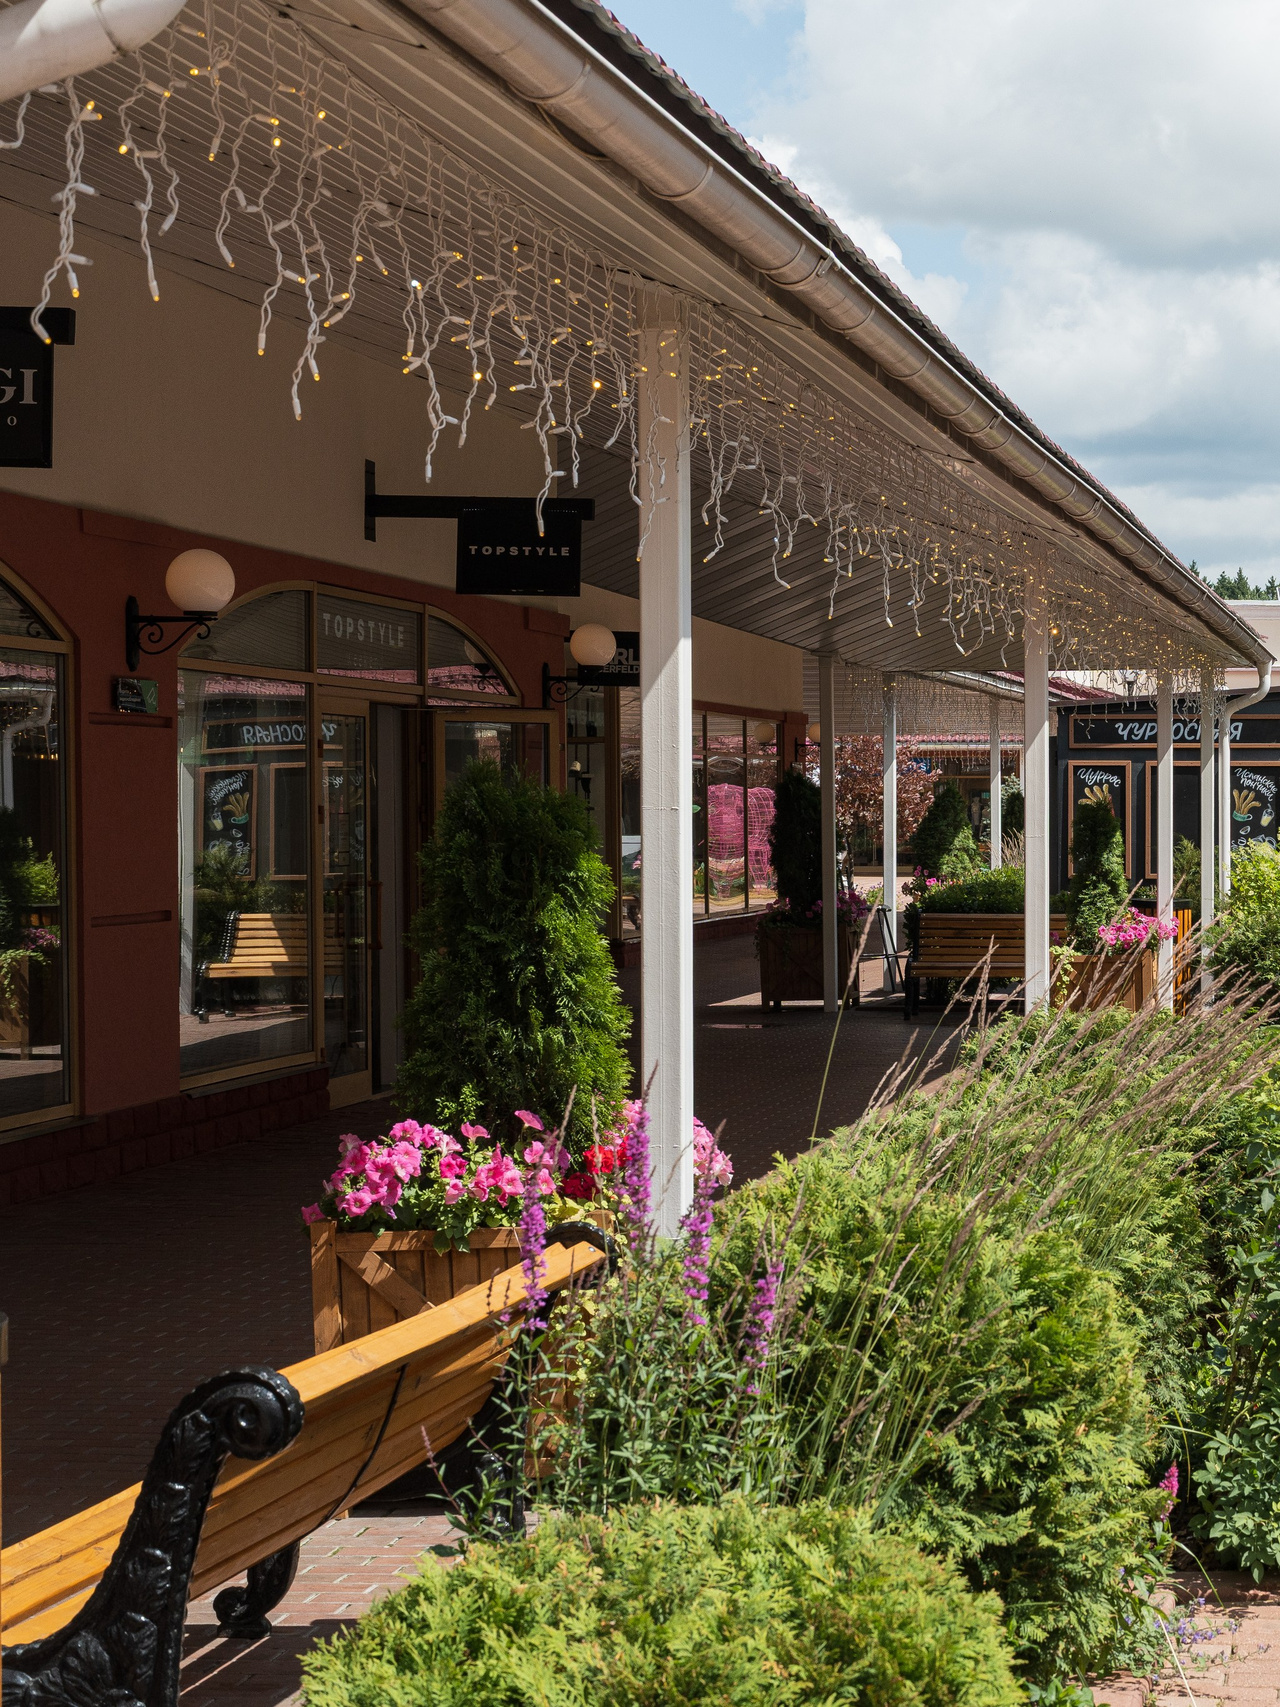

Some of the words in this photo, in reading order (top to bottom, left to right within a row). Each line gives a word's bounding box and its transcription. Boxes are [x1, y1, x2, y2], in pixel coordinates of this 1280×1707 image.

[468, 545, 570, 557] TOPSTYLE
[322, 613, 404, 648] TOPSTYLE
[1077, 768, 1121, 787] Чуррос
[1234, 767, 1278, 794] Испанские
